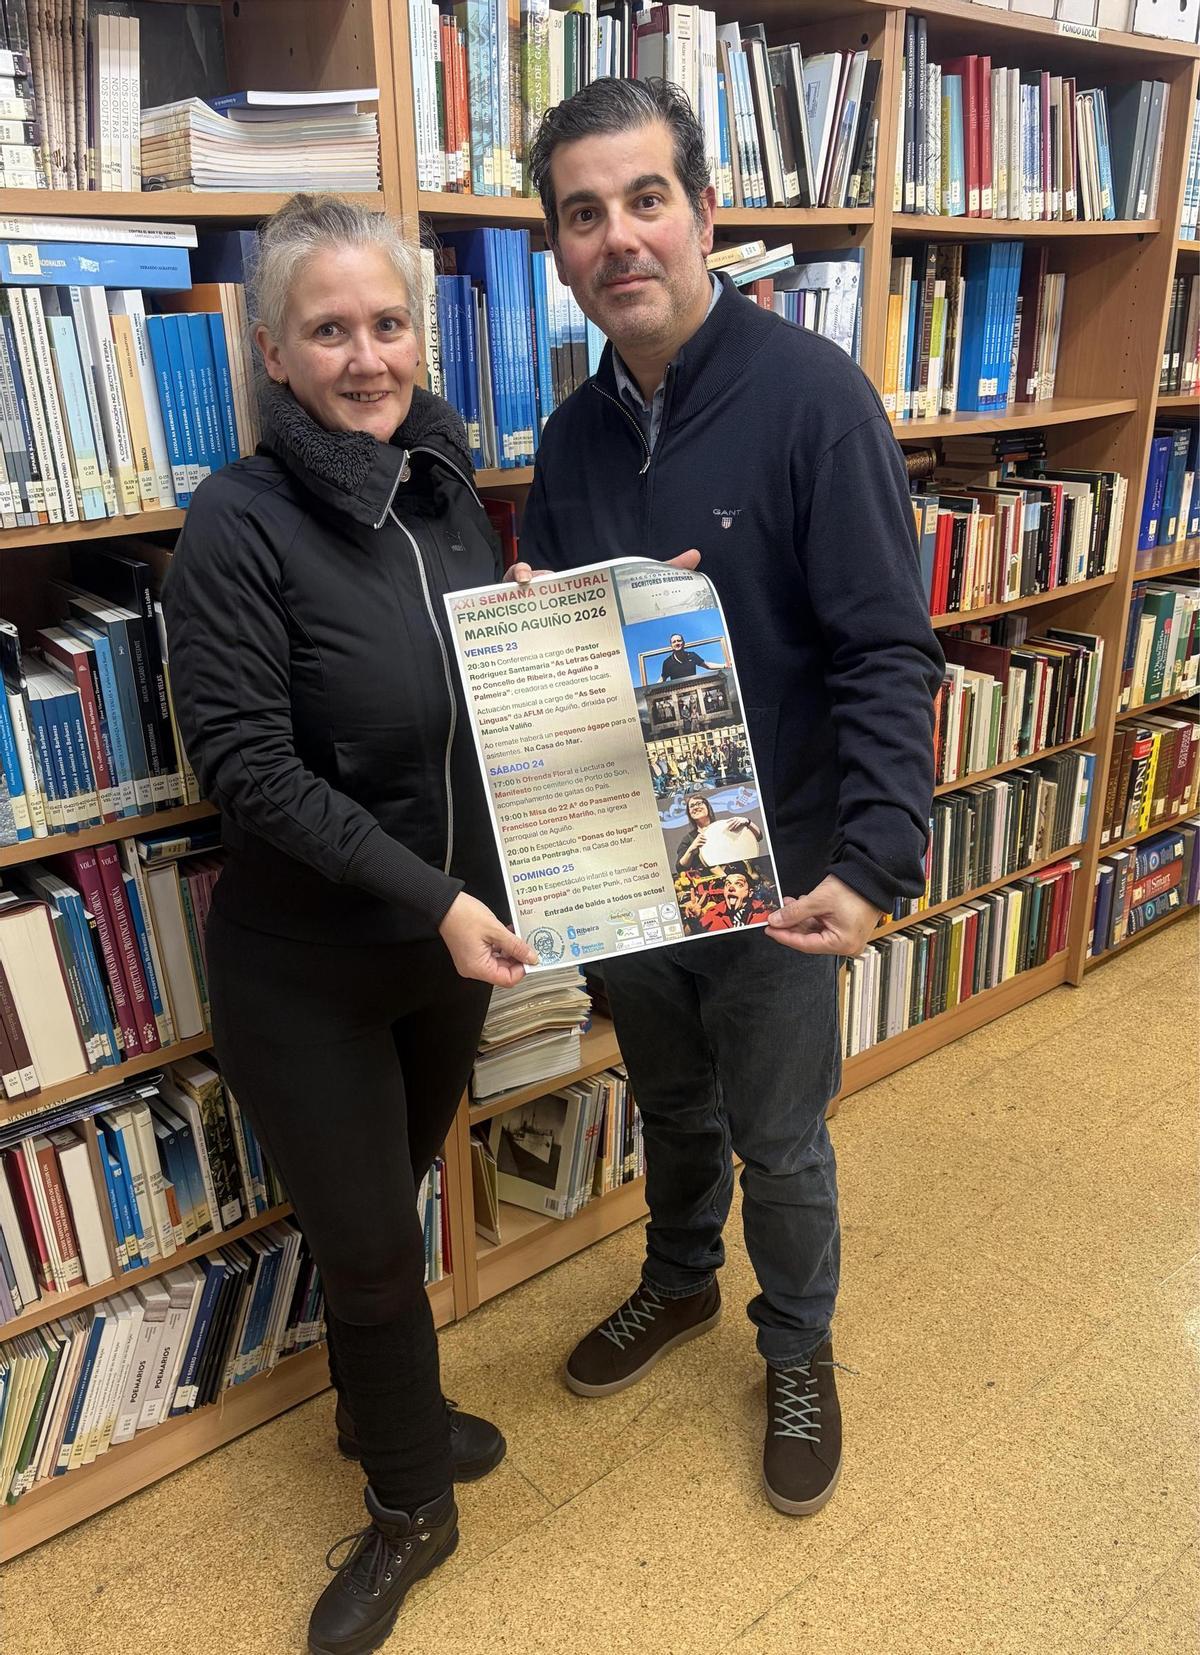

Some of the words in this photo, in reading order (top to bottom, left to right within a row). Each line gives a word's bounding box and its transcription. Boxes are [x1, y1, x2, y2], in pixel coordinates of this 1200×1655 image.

[1062, 23, 1081, 35] FONDO
[1082, 27, 1097, 38] LOCAL
[106, 364, 115, 392] SECTOR
[110, 392, 116, 403] NO
[712, 508, 742, 516] GANT
[453, 598, 475, 611] XXI
[479, 588, 536, 607] SEMANA
[539, 573, 608, 595] CULTURAL
[456, 601, 537, 624] FRANCISCO
[540, 588, 606, 610] LORENZO
[465, 618, 518, 641] MARIÑO
[521, 612, 571, 632] AGUIÑO
[574, 606, 607, 623] 2026
[464, 645, 504, 658] VENRES
[505, 642, 518, 651] 23
[467, 661, 490, 671] 20:30
[497, 653, 538, 666] Conferencia
[544, 649, 565, 660] cargo
[565, 647, 575, 655] de
[575, 642, 600, 653] Pastor
[565, 655, 589, 665] Letras
[590, 649, 620, 661] Galegas
[471, 684, 482, 692] no
[482, 678, 515, 689] Concello
[516, 676, 526, 684] de
[557, 669, 567, 677] de
[567, 665, 593, 676] Aguiño
[514, 682, 548, 695] creadoras
[554, 677, 589, 689] creadores
[477, 703, 511, 716] Actuación
[511, 699, 538, 710] musical
[544, 695, 564, 705] cargo
[588, 686, 606, 696] Sete
[523, 709, 544, 718] AFLM
[580, 698, 607, 709] dirixida
[606, 694, 618, 704] por
[481, 726, 509, 736] Manola
[494, 737, 519, 747] remate
[554, 725, 586, 739] pequeno
[587, 720, 610, 733] ágape
[611, 718, 627, 729] para
[535, 741, 554, 751] Casa
[555, 739, 565, 747] do
[565, 737, 583, 745] Mar.
[493, 778, 515, 789] 17:00
[522, 772, 553, 783] Ofrenda
[553, 768, 574, 779] Floral
[580, 764, 606, 774] Lectura
[605, 760, 615, 768] de
[531, 759, 545, 769] 24
[494, 787, 532, 799] Manifesto
[574, 776, 584, 784] de
[585, 773, 603, 783] Porto
[603, 770, 613, 779] do
[496, 792, 553, 809] acompañamento
[554, 790, 564, 799] de
[564, 787, 585, 799] gaitas
[500, 812, 522, 822] 19:00
[529, 807, 547, 817] Misa
[547, 806, 558, 814] do
[589, 793, 629, 806] Pasamento
[629, 790, 641, 798] de
[501, 821, 538, 833] Francisco
[538, 815, 568, 826] Lorenzo
[606, 803, 628, 814] igrexa
[504, 830, 538, 844] parroquial
[506, 846, 530, 857] 20:00
[536, 838, 577, 851] Espectáculo
[605, 829, 615, 838] do
[640, 822, 653, 831] con
[531, 854, 541, 863] da
[591, 841, 610, 850] Casa
[610, 839, 619, 847] do
[620, 837, 636, 845] Mar.
[512, 867, 561, 883] DOMINGO
[561, 863, 575, 873] 25
[516, 885, 538, 896] 17:30
[544, 876, 586, 890] Espectáculo
[586, 870, 608, 881] infantil
[614, 865, 639, 876] familiar
[517, 896, 542, 906] Lingua
[582, 884, 602, 893] Peter
[633, 874, 651, 883] Casa
[544, 905, 574, 917] Entrada
[574, 903, 584, 911] de
[585, 898, 606, 908] balde
[612, 893, 632, 903] todos
[643, 886, 665, 897] actos!
[576, 925, 600, 935] Ribeira
[130, 1360, 146, 1403] POEMARIOS
[155, 1347, 170, 1389] POEMARIOS
